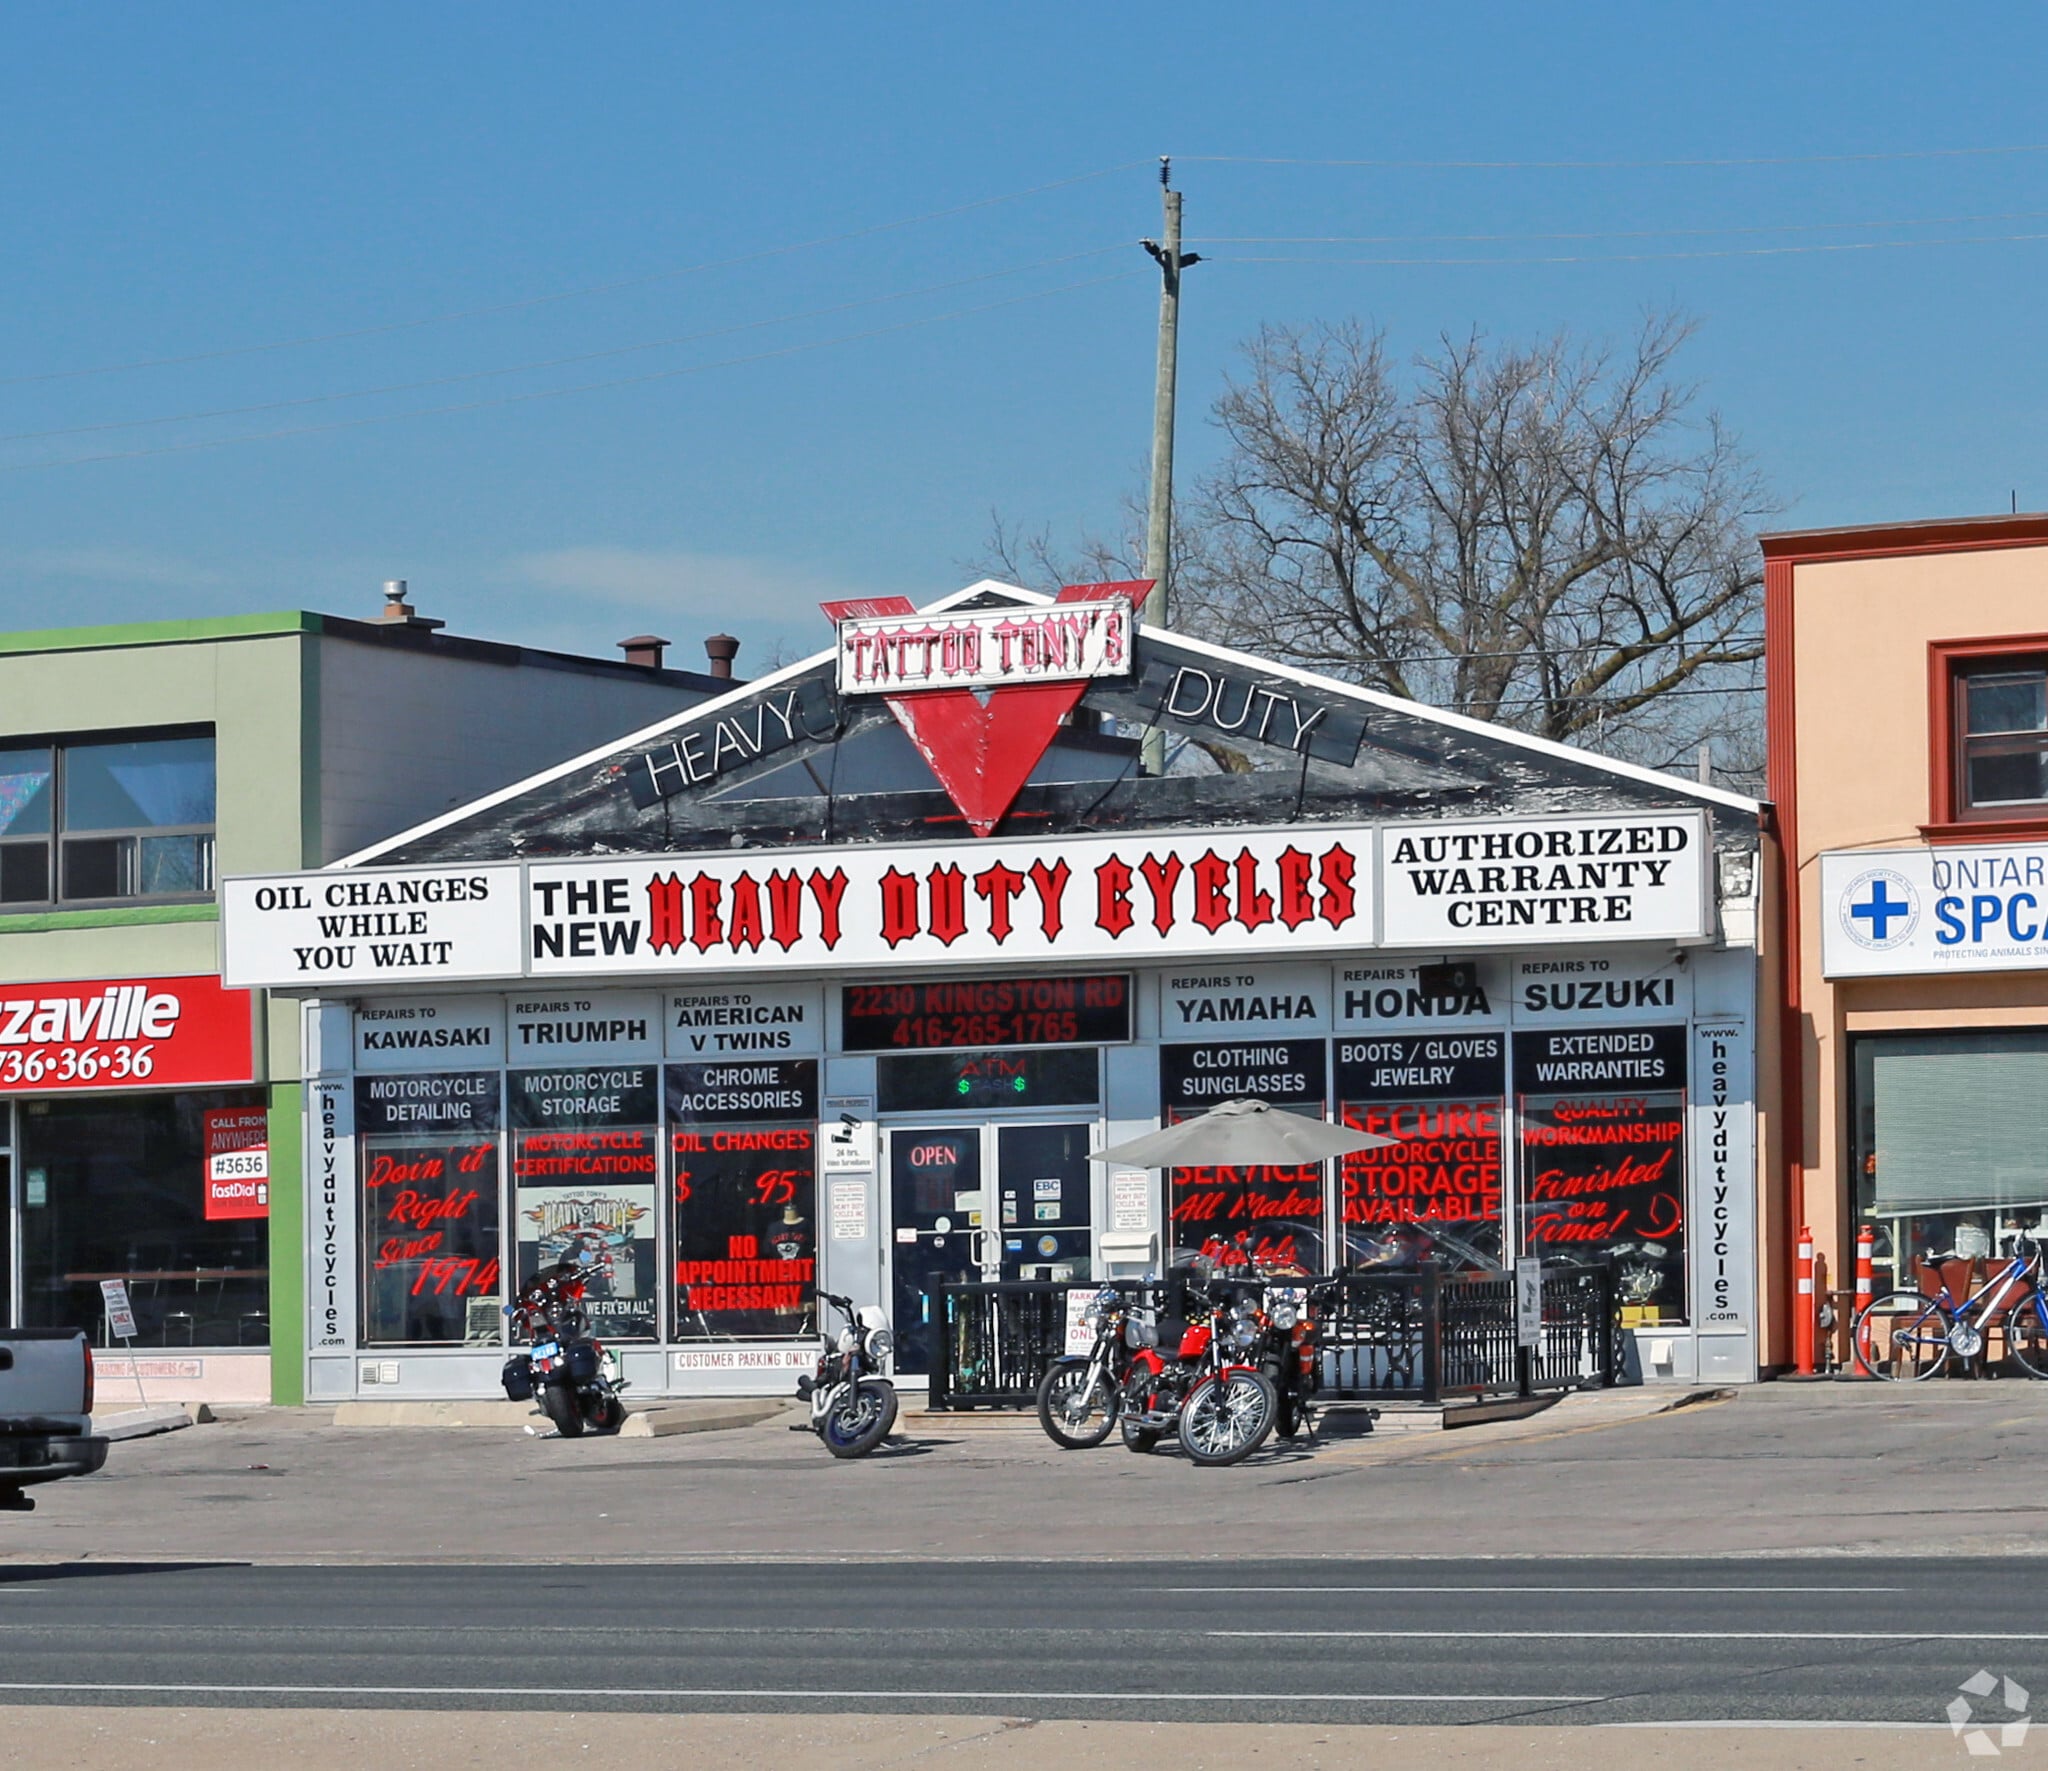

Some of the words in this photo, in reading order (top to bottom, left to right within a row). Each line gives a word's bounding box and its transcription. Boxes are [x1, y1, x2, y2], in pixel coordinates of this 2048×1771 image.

[846, 619, 982, 685] TATTOO
[1167, 666, 1326, 750] DUTY
[645, 690, 796, 796] HEAVY
[1391, 825, 1688, 864] AUTHORIZED
[1407, 860, 1672, 896] WARRANTY
[254, 886, 312, 911] OIL
[325, 876, 490, 908] CHANGES
[533, 878, 632, 917] THE
[645, 864, 849, 956] HEAVY
[878, 856, 1072, 951] DUTY
[1093, 841, 1356, 941] CYCLES
[1446, 895, 1632, 928] CENTRE
[1934, 892, 2048, 945] SPC
[317, 911, 428, 938] WHILE
[533, 920, 641, 958] NEW
[293, 946, 356, 970] YOU
[369, 941, 453, 967] WAIT
[1990, 947, 2032, 956] ANIMALS
[1344, 969, 1405, 981] REPAIRS
[1522, 961, 1585, 974] REPAIRS
[1590, 960, 1609, 971] TO
[1171, 976, 1231, 989] REPAIRS
[1236, 975, 1254, 986] TO
[674, 996, 729, 1008] REPAIRS
[733, 994, 751, 1005] TO
[851, 984, 916, 1016] 2230
[925, 978, 1075, 1014] KINGSTON
[1085, 976, 1124, 1007] RD
[1524, 978, 1675, 1012] SUZUKI
[362, 1009, 415, 1020] REPAIRS
[419, 1008, 436, 1018] TO
[516, 1001, 570, 1014] REPAIRS
[574, 1001, 591, 1011] TO
[677, 1005, 803, 1027] AMERICAN
[1177, 995, 1316, 1023] YAMAHA
[364, 1027, 490, 1050] KAWASAKI
[518, 1019, 647, 1044] TRIUMPH
[893, 1011, 1078, 1046] 416-265-1765
[1700, 1030, 1738, 1038] www.
[690, 1035, 706, 1051] V
[713, 1031, 791, 1050] TWINS
[1341, 1044, 1402, 1063] BOOTS
[1408, 1042, 1420, 1064] /
[1425, 1039, 1498, 1060] GLOVES
[1549, 1034, 1654, 1056] EXTENDED
[960, 1058, 1025, 1077] ATM
[1193, 1047, 1288, 1068] CLOTHING
[524, 1071, 643, 1093] MOTORCYCLE
[703, 1067, 779, 1087] CHROME
[1370, 1066, 1455, 1087] JEWELRY
[1536, 1059, 1665, 1082] WARRANTIES
[370, 1078, 486, 1099] MOTORCYCLE
[1182, 1073, 1305, 1095] SUNGLASSES
[386, 1102, 471, 1121] DETAILING
[542, 1095, 620, 1116] STORAGE
[680, 1090, 802, 1111] ACCESSORIES
[1554, 1097, 1648, 1122] QUALITY
[211, 1118, 236, 1129] CALL
[239, 1116, 267, 1127] FROM
[1341, 1103, 1500, 1140] SECURE
[1523, 1121, 1682, 1146] WORKMANSHIP
[524, 1131, 643, 1152] MOTORCYCLE
[672, 1133, 706, 1152] OIL
[712, 1129, 811, 1151] CHANGES
[1341, 1140, 1498, 1164] MOTORCYCLE
[216, 1157, 263, 1174] #3636
[458, 1141, 494, 1173] it
[513, 1155, 658, 1176] CERTIFICATIONS
[911, 1145, 957, 1167] OPEN
[1036, 1181, 1059, 1191] EBC
[1340, 1163, 1502, 1197] STORAGE
[1529, 1148, 1674, 1201] Finished
[1712, 1040, 1728, 1309] heavydutycycles
[676, 1171, 692, 1203] $
[323, 1094, 336, 1335] heavydutycycles
[387, 1188, 479, 1230] Right
[1168, 1191, 1228, 1221] All
[1340, 1196, 1500, 1224] AVAILABLE
[1568, 1201, 1609, 1218] on
[374, 1231, 444, 1270] Since
[728, 1235, 758, 1259] NO
[411, 1256, 500, 1297] 1974
[676, 1258, 814, 1285] APPOINTMENT
[585, 1301, 600, 1315] WE
[687, 1285, 803, 1311] NECESSARY
[1706, 1310, 1738, 1320] .com
[318, 1336, 345, 1345] .com
[680, 1353, 734, 1367] CUSTOMER
[739, 1352, 780, 1366] PARKING
[785, 1352, 811, 1366] ONLY
